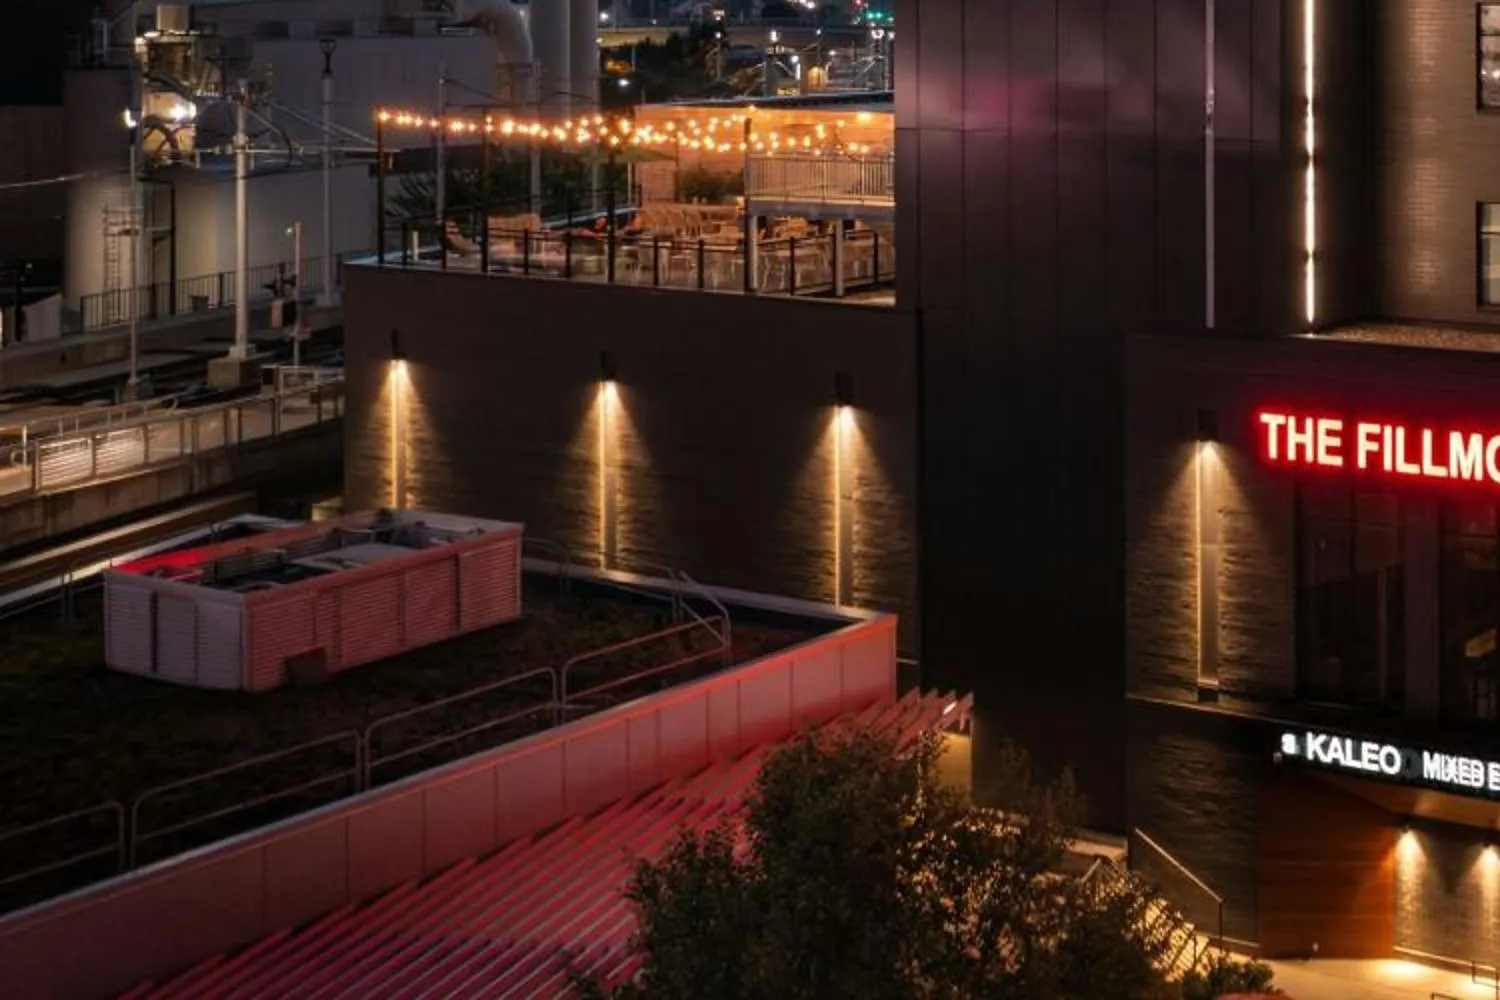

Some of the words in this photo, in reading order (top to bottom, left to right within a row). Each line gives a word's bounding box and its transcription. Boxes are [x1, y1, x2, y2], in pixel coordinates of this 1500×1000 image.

[1259, 412, 1343, 467] THE
[1306, 731, 1402, 775] KALEO
[1422, 750, 1485, 788] MIXED
